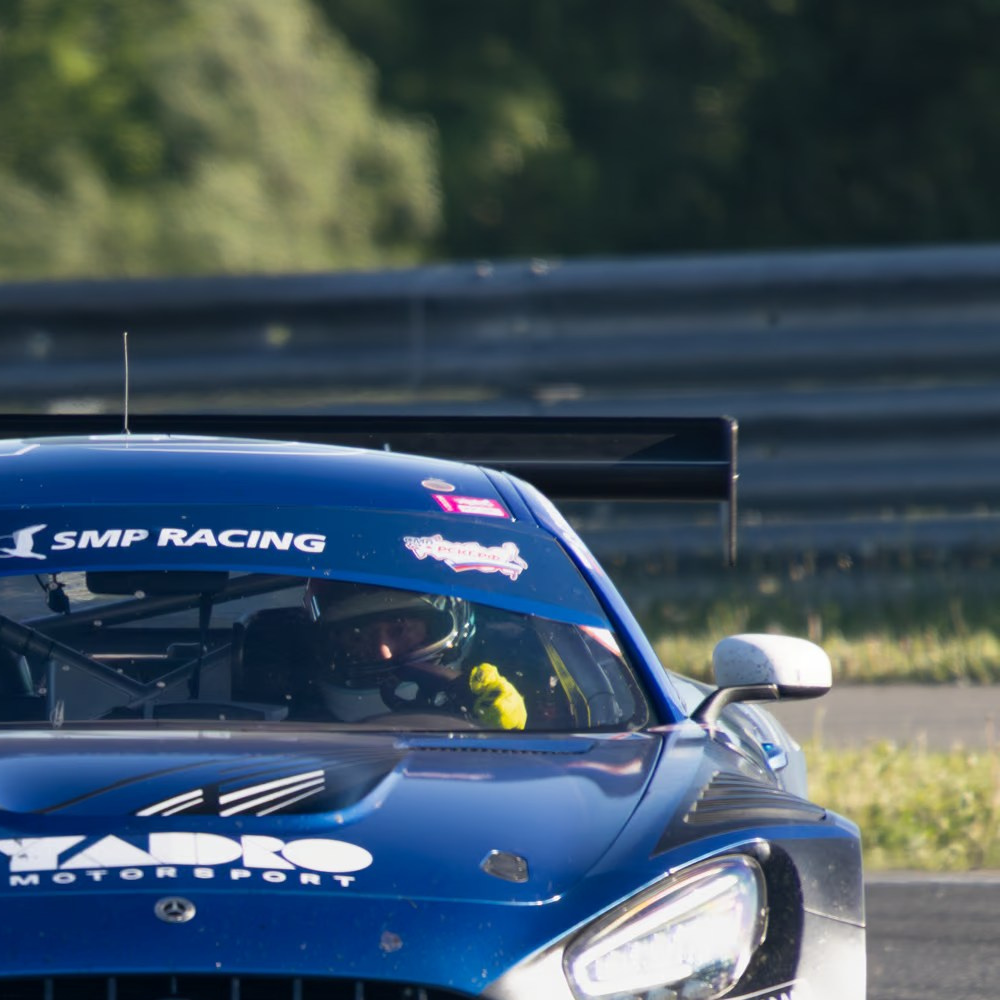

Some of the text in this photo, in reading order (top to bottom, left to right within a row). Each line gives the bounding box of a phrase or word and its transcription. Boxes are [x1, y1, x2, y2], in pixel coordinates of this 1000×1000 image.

[51, 528, 326, 553] SMP RACING
[9, 866, 356, 887] MOTORSPORT
